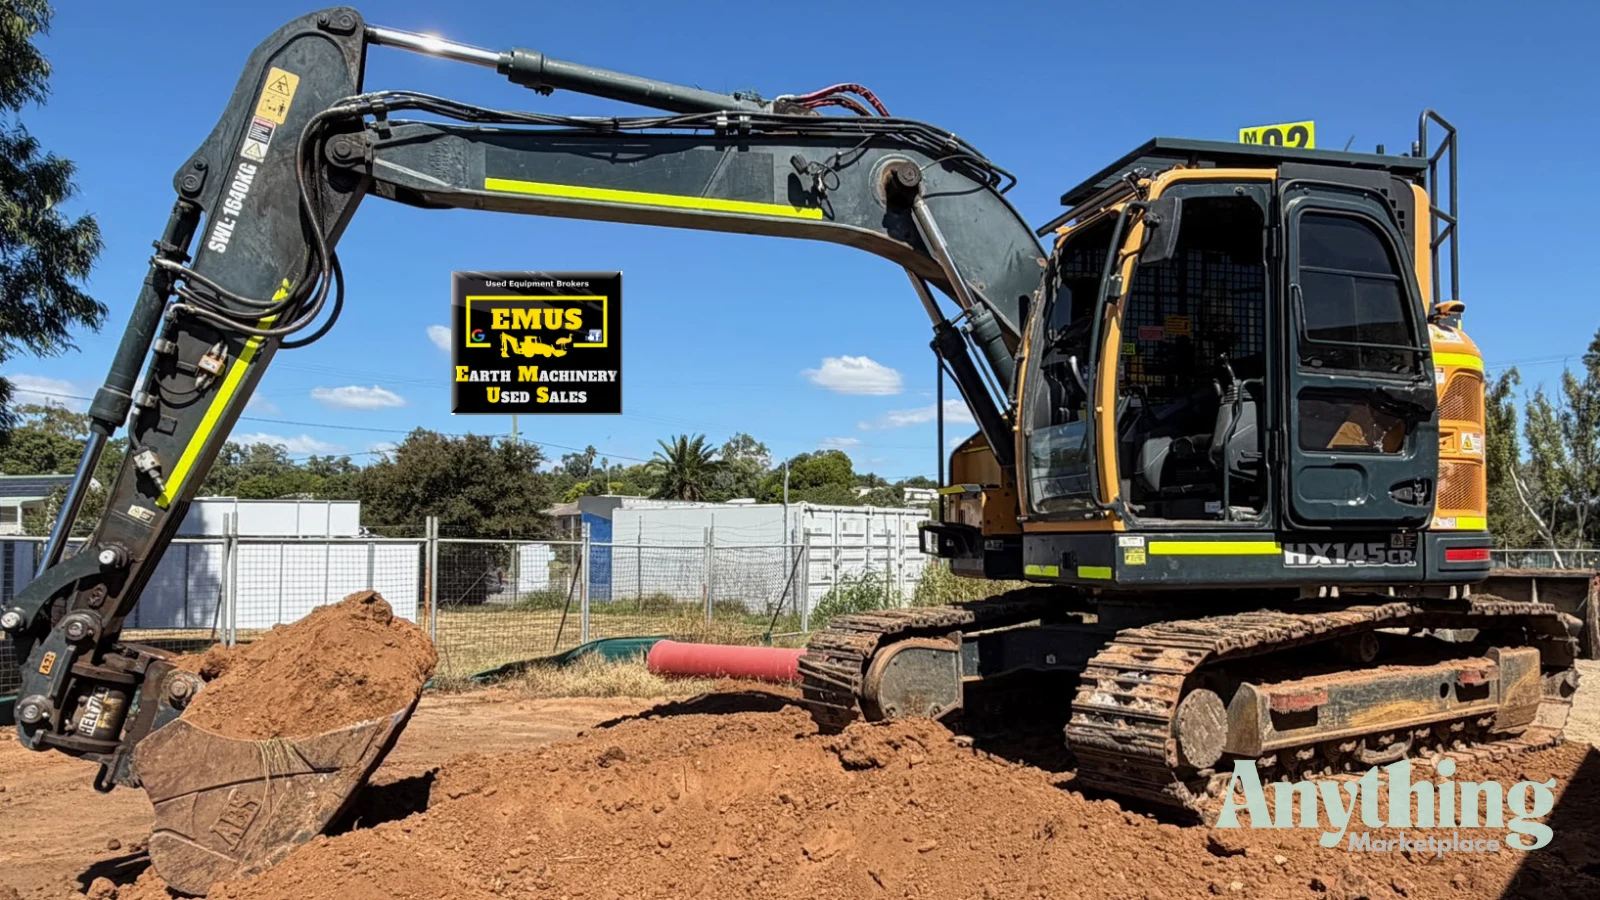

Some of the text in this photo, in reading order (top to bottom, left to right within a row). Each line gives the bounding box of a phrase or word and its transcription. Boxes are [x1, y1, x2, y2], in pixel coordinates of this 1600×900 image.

[1243, 131, 1257, 144] M
[208, 162, 258, 254] SWL: 1640KG
